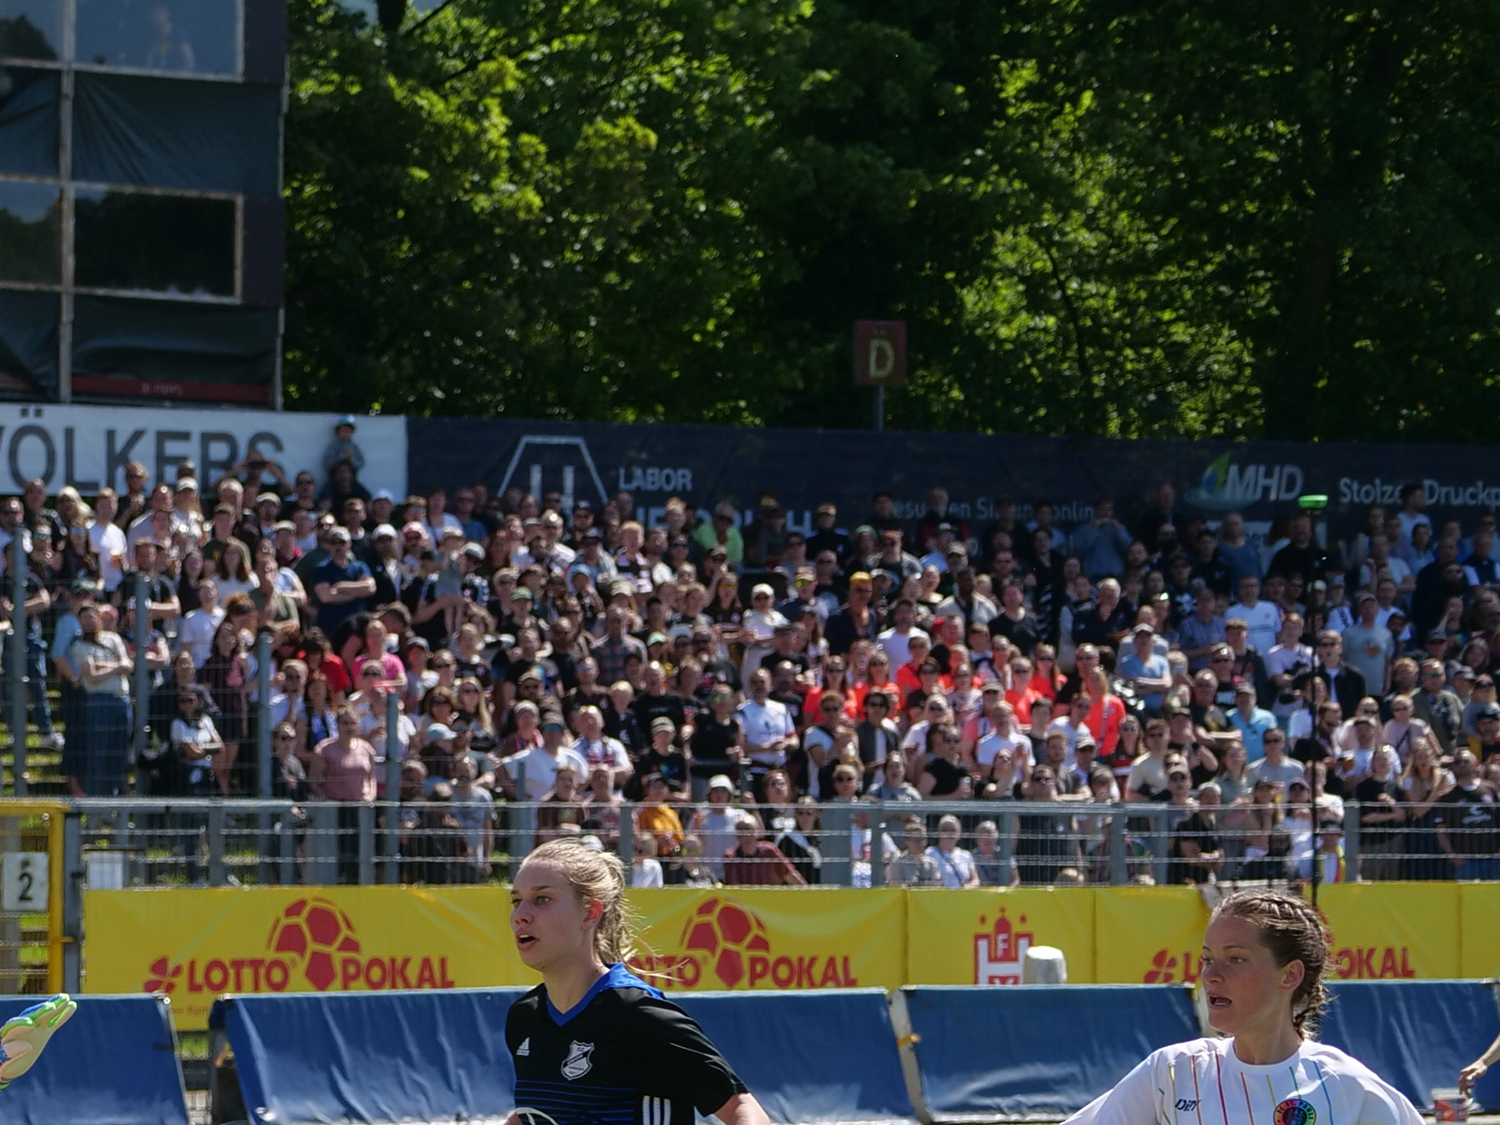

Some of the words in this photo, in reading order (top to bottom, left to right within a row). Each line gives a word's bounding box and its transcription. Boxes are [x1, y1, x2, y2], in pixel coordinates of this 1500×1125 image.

[869, 339, 895, 378] D
[618, 467, 692, 491] LABOR
[1225, 464, 1304, 501] MHD
[18, 872, 33, 901] 2
[188, 958, 289, 992] LOTTO
[342, 956, 455, 990] POKAL
[629, 955, 700, 988] OTTO
[749, 955, 858, 988] POKAL
[1338, 946, 1416, 980] OKAL
